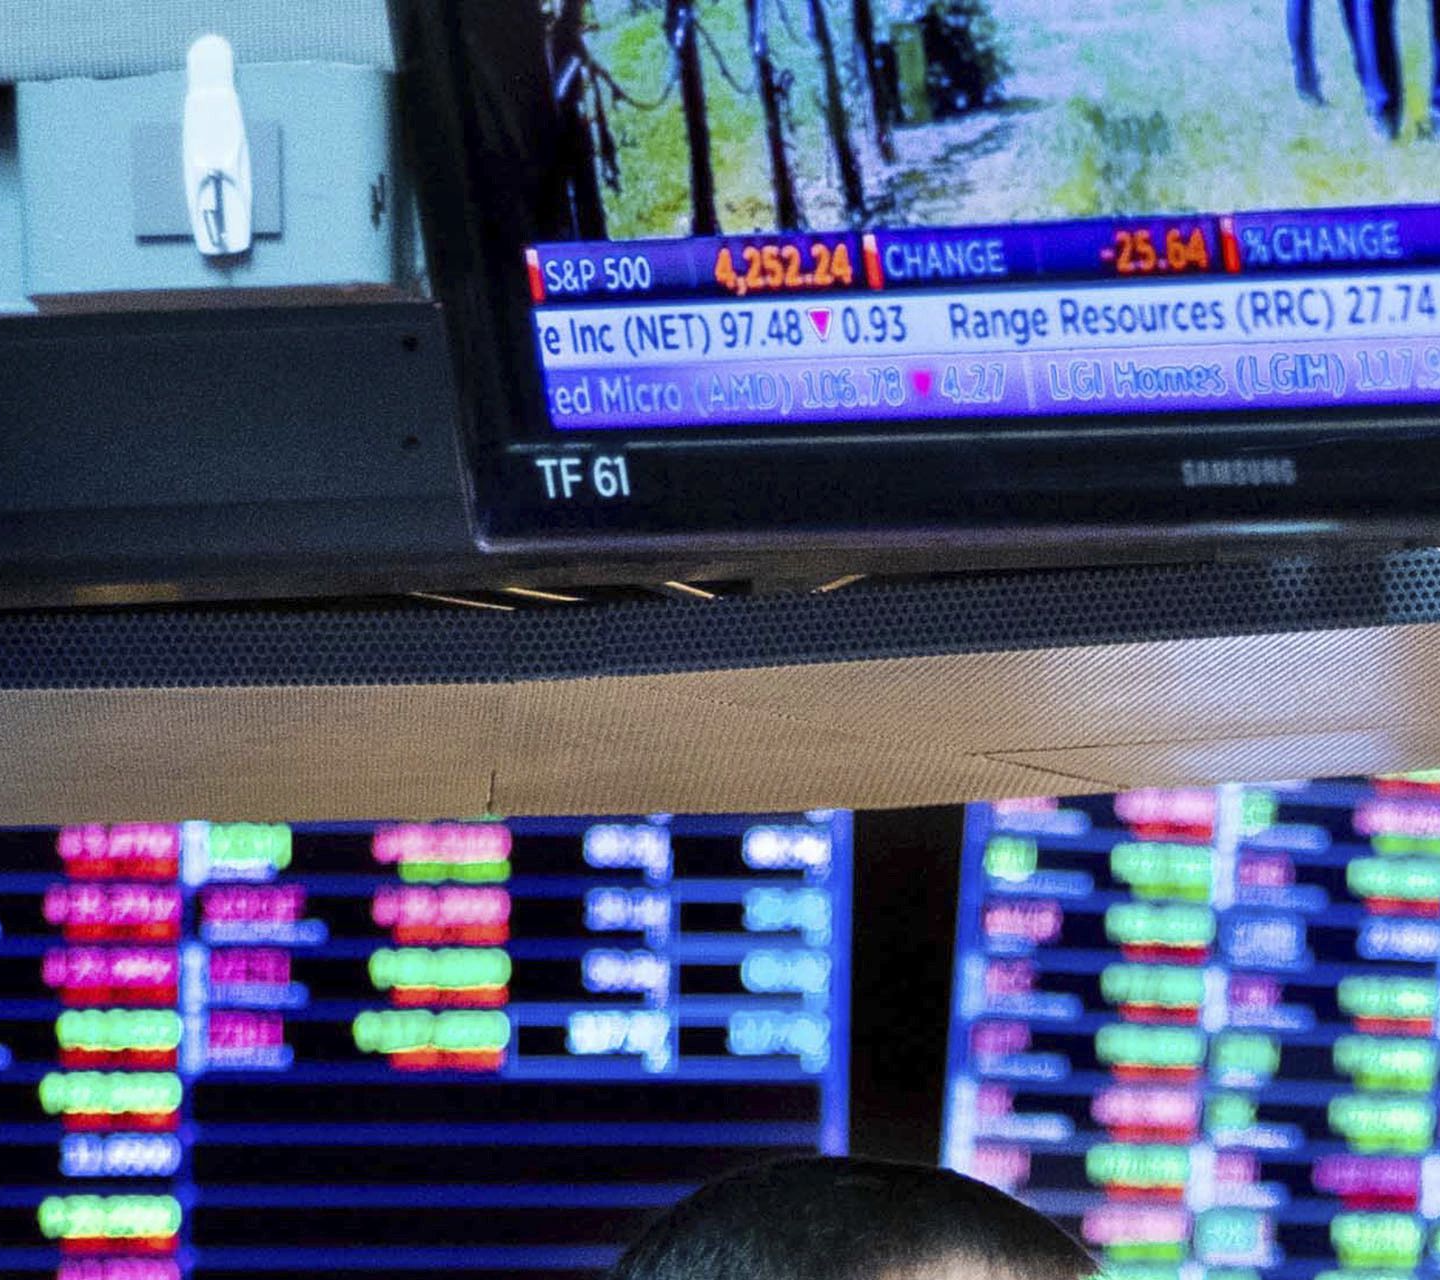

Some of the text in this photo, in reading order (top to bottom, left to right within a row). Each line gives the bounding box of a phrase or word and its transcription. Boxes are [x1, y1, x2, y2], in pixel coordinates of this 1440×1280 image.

[545, 256, 595, 291] S&P
[603, 253, 651, 290] 500
[713, 242, 853, 296] 4,252.24
[886, 239, 1006, 279] CHANGE
[1101, 227, 1208, 275] -25.64
[569, 316, 615, 356] Inc
[623, 308, 712, 358] (NET)
[720, 309, 803, 350] 97.48
[842, 306, 908, 346] 0.93
[949, 299, 1050, 347] Range
[1059, 292, 1226, 338] Resources
[1234, 286, 1335, 336] (RRC)
[1345, 283, 1436, 328] 27.74
[600, 375, 682, 415] Micro
[693, 366, 794, 418] (AMD)
[801, 364, 903, 408] 106.78
[940, 362, 1007, 401] 4.27
[1048, 361, 1103, 401] LGI
[1111, 357, 1227, 399] Homes
[1233, 348, 1347, 402] (LGIH)
[537, 456, 632, 500] TF 61
[1182, 458, 1297, 487] SAMSUNG
